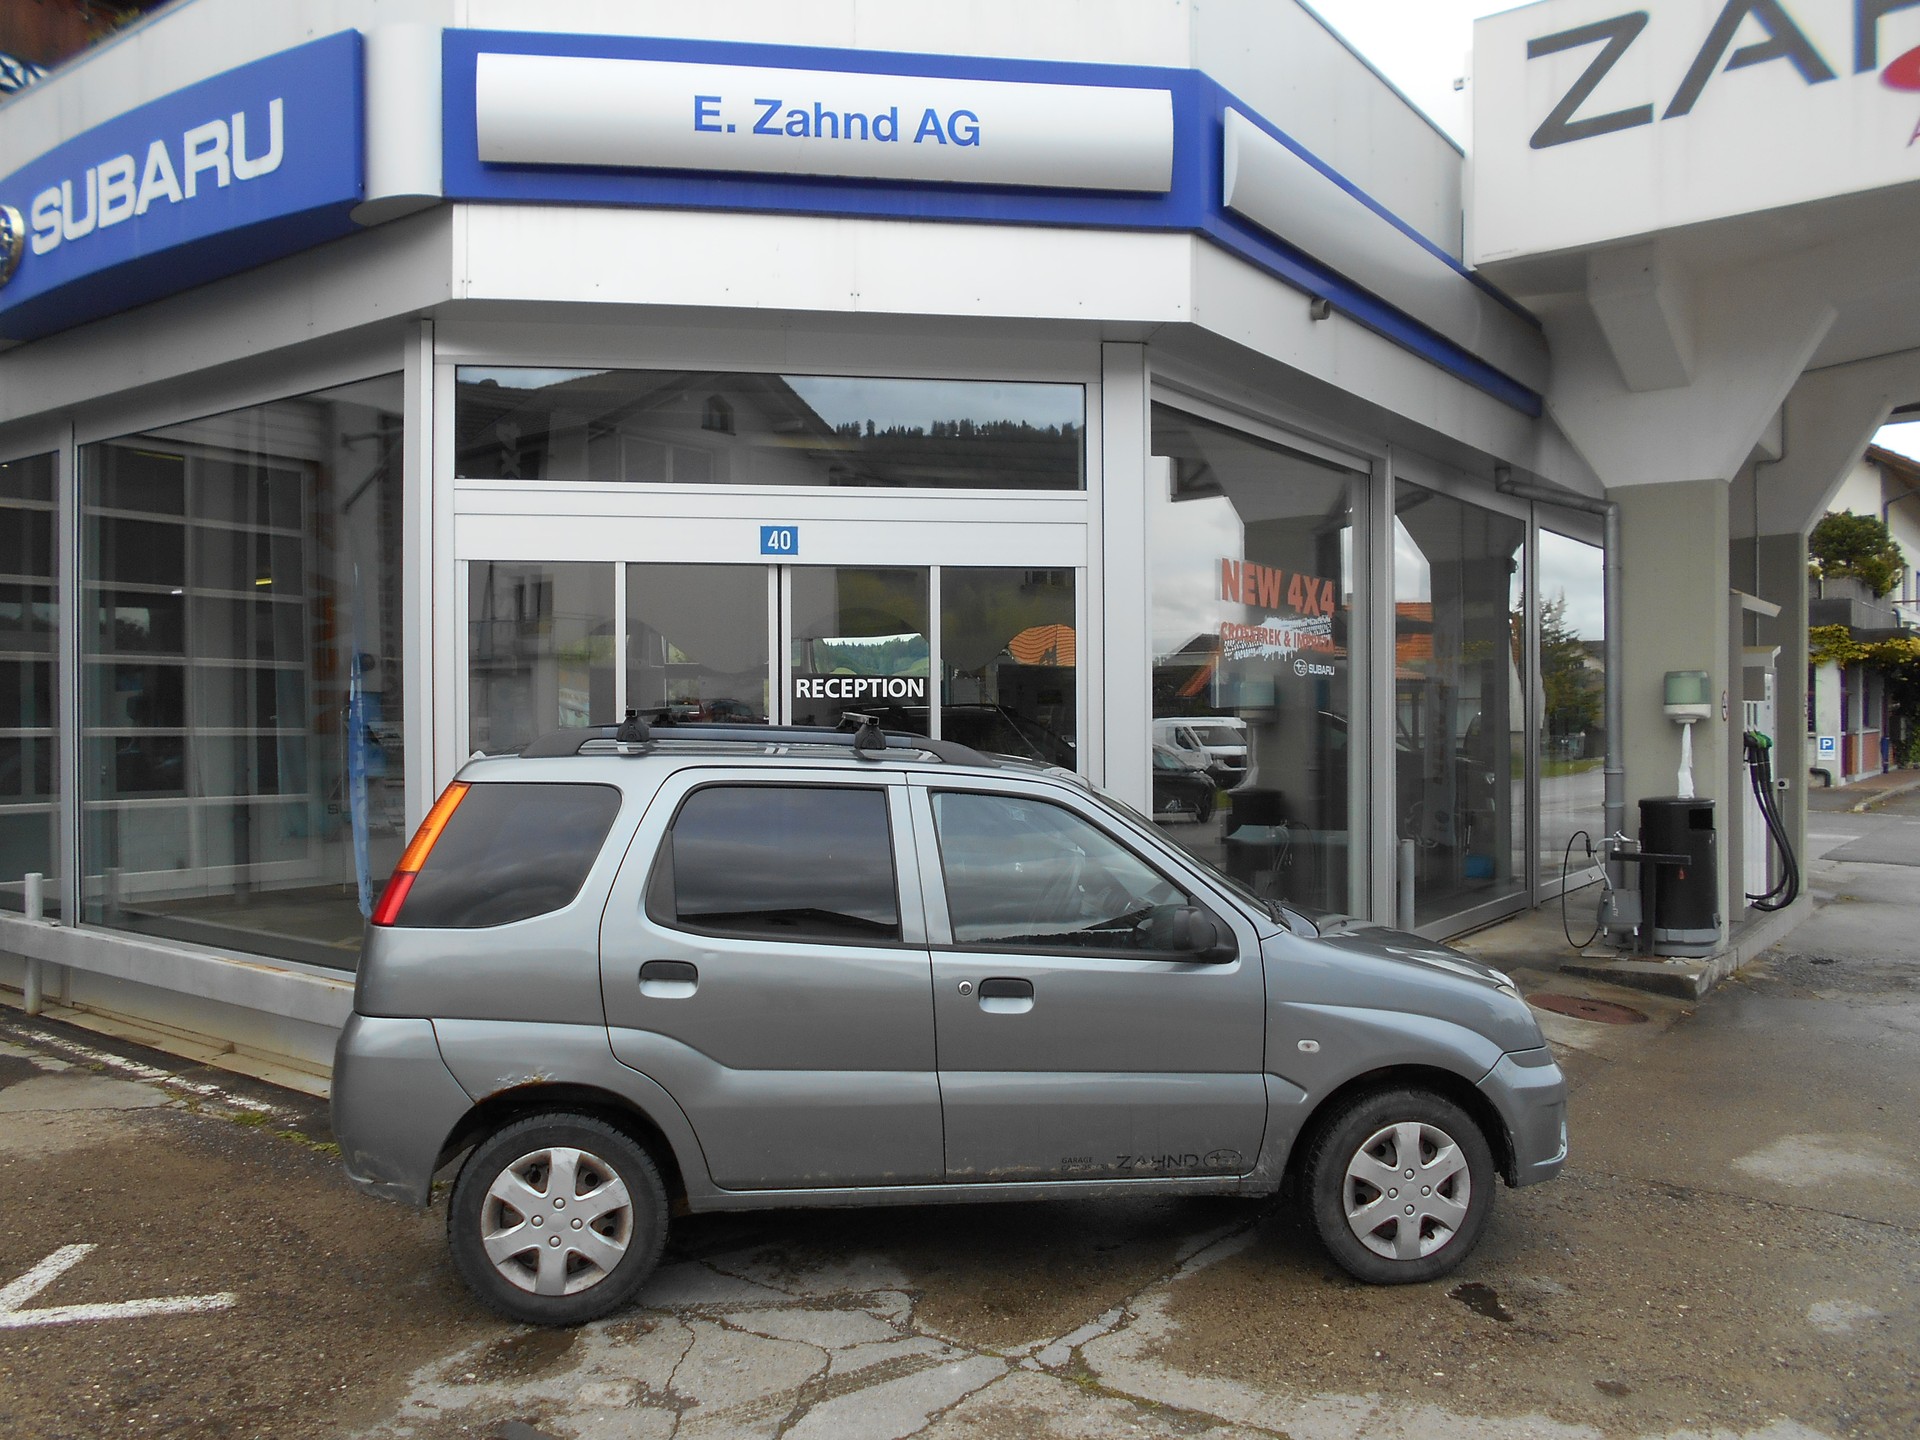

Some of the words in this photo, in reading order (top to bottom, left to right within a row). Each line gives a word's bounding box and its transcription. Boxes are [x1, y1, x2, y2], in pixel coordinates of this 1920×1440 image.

[694, 95, 736, 133] E.
[752, 98, 899, 143] Zahnd
[913, 108, 980, 147] AG
[31, 98, 284, 256] SUBARU
[767, 530, 791, 551] 40
[1221, 558, 1284, 609] NEW
[1287, 573, 1336, 619] 4X4
[1283, 630, 1291, 647] &
[1308, 663, 1335, 675] SUBARU
[795, 677, 925, 699] RECEPTION
[1822, 739, 1832, 750] P
[1062, 1156, 1092, 1164] GARAGE
[1116, 1153, 1199, 1170] ZAHND
